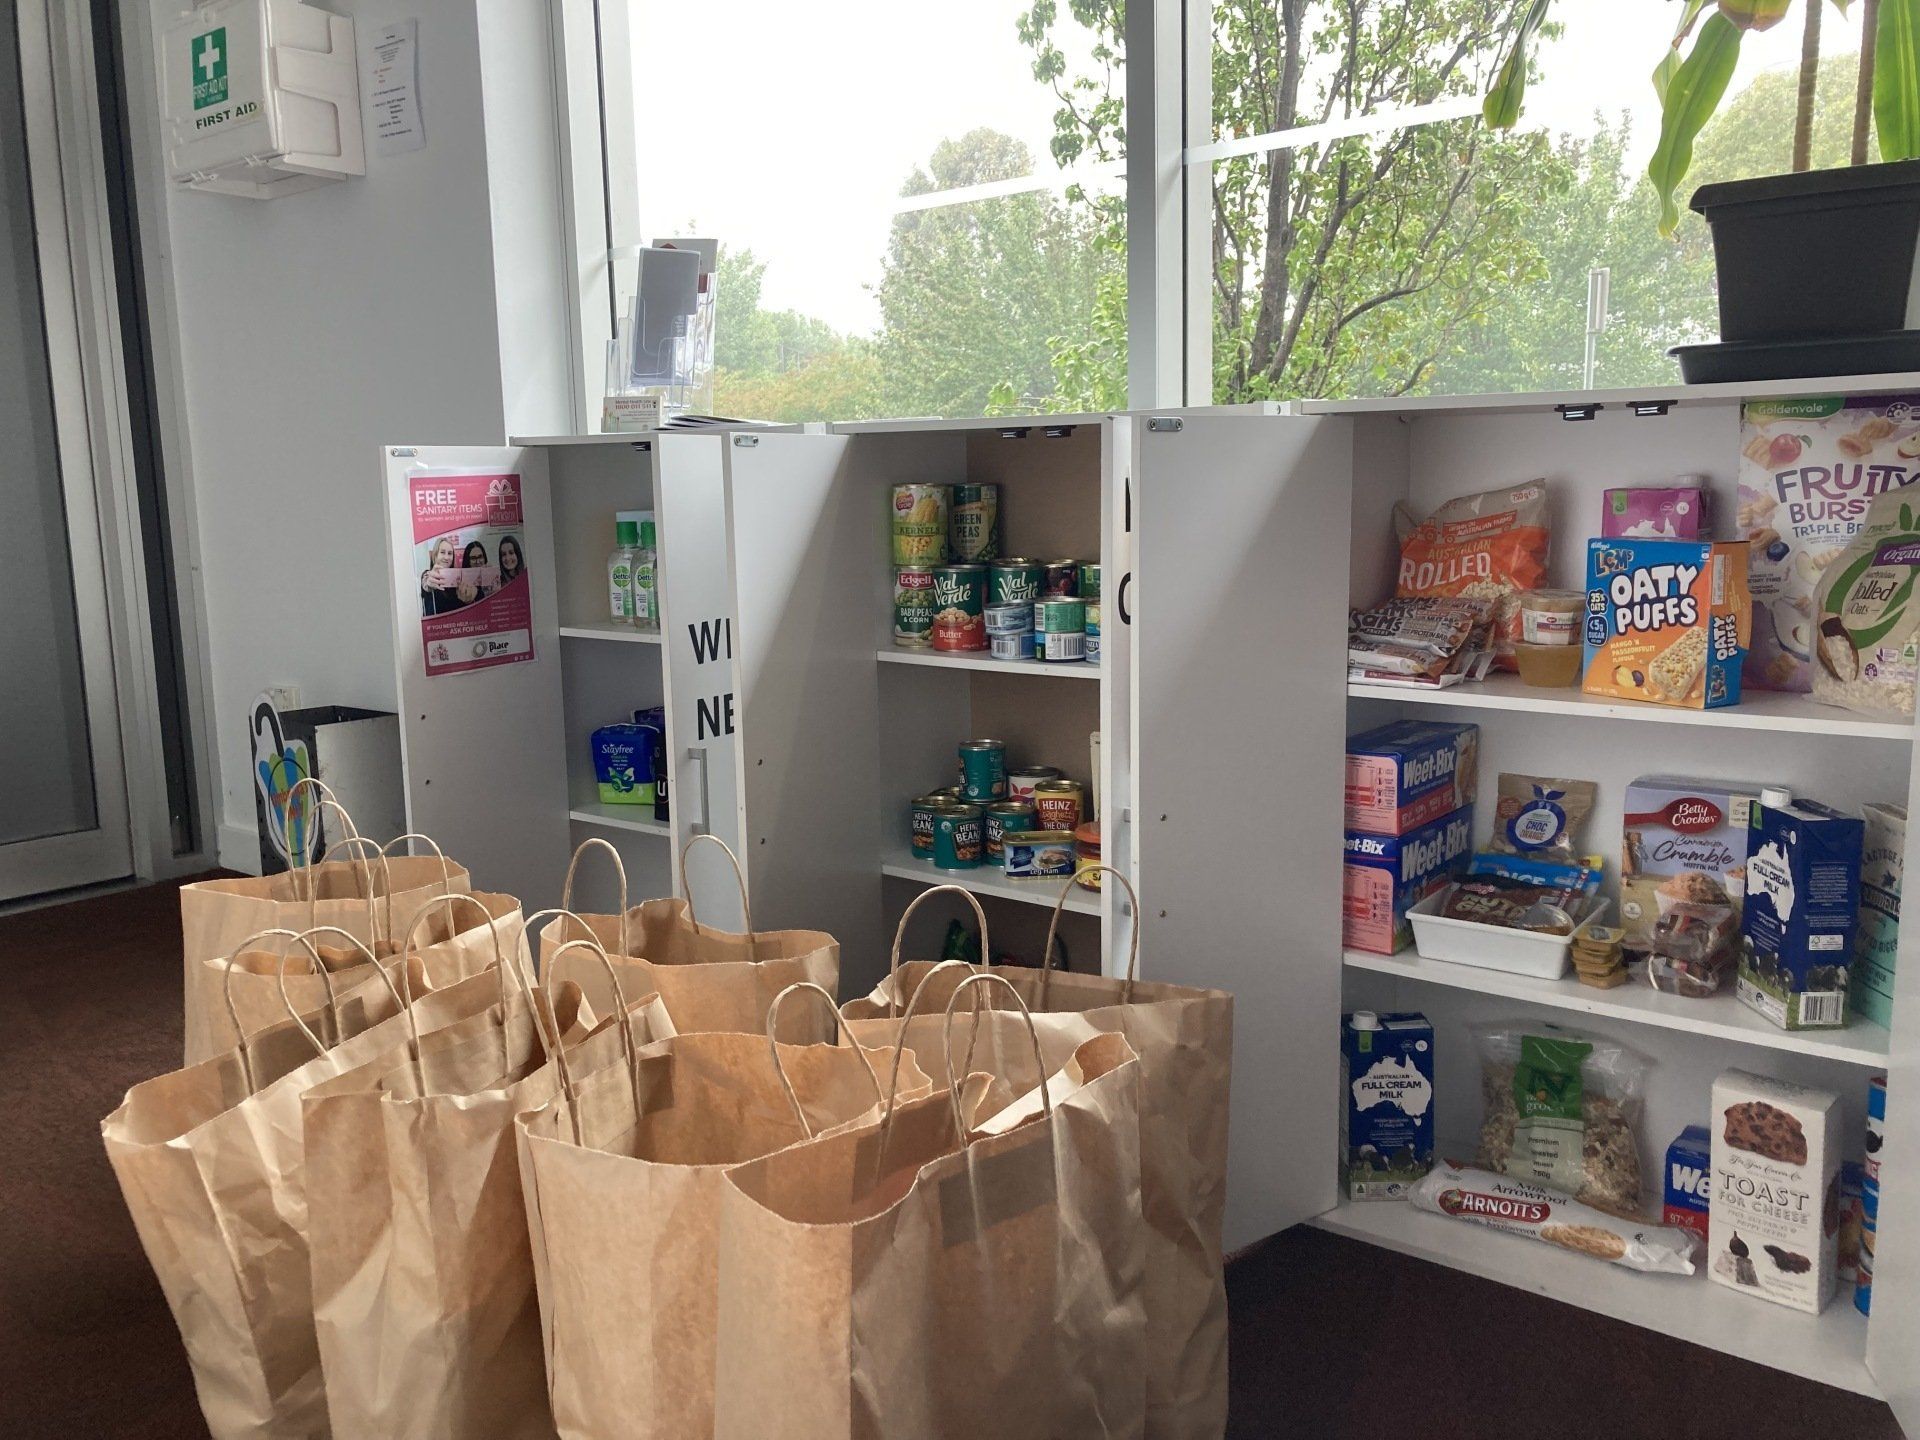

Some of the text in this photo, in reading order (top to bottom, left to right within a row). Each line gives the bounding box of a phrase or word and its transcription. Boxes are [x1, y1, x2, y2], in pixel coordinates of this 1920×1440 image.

[193, 82, 208, 99] FIRST
[209, 79, 219, 94] AID
[196, 102, 258, 130] FIRST AID
[1758, 403, 1824, 416] Goldenvale
[415, 488, 457, 506] FREE
[416, 503, 483, 516] SANITARY ITEMS
[1789, 498, 1872, 524] BURS
[954, 513, 982, 525] GREEN
[900, 526, 941, 535] KERNELS
[956, 526, 980, 538] PEAS
[1456, 522, 1492, 537] AUSTRALIAN
[1791, 523, 1841, 538] TRIPLE
[1426, 538, 1492, 560] AUSTRALIAN
[1398, 552, 1492, 591] ROLLED
[900, 575, 931, 587] Edgell
[934, 573, 958, 594] Val
[998, 571, 1026, 595] Val
[1610, 564, 1698, 607] OATY
[1590, 592, 1606, 603] 35%
[900, 607, 933, 617] BABY PEAS
[1590, 602, 1606, 612] OATS
[1850, 602, 1869, 615] Oats
[1615, 597, 1698, 634] PUFFS
[443, 622, 456, 630] NEED
[449, 624, 489, 635] ASK FOR HELP
[939, 629, 963, 639] Butter
[1410, 629, 1448, 641] PROTEIN BAR
[1588, 631, 1605, 640] SUGAR
[1713, 615, 1730, 661] OATY
[1725, 613, 1738, 657] PUFFS
[488, 641, 509, 653] place
[1610, 641, 1633, 650] MANGO
[1611, 645, 1656, 657] PASSIONFRUIT
[601, 743, 634, 756] Stayfree
[1403, 747, 1456, 790] Weet-Bix
[1042, 800, 1071, 811] HEINZ
[1679, 803, 1708, 817] Betty
[914, 812, 933, 822] HEINZ
[1671, 813, 1716, 826] Crocker
[1043, 821, 1071, 830] THE ONE
[1525, 820, 1548, 833] CHOC
[1520, 829, 1546, 841] ORANGE
[1674, 834, 1724, 848] Cinnamon
[1402, 818, 1470, 883] Weet-Bix
[1652, 840, 1736, 866] Crumble
[1043, 867, 1059, 875] Ham
[1683, 861, 1707, 870] MUFFIN
[1761, 858, 1785, 874] AUSTRALIAN
[1753, 863, 1790, 888] FULL CREAM
[1764, 879, 1780, 896] MILK
[1361, 1081, 1422, 1091] FULL CREAM
[1379, 1090, 1404, 1099] MILK
[1527, 1135, 1560, 1146] Premium
[1532, 1169, 1551, 1180] 750g
[1671, 1162, 1711, 1199] We
[1491, 1183, 1568, 1206] Arrowroot
[1717, 1169, 1810, 1211] TOAST
[1462, 1193, 1542, 1220] ARNOTT'S
[1718, 1188, 1810, 1226] FOR CHEESE
